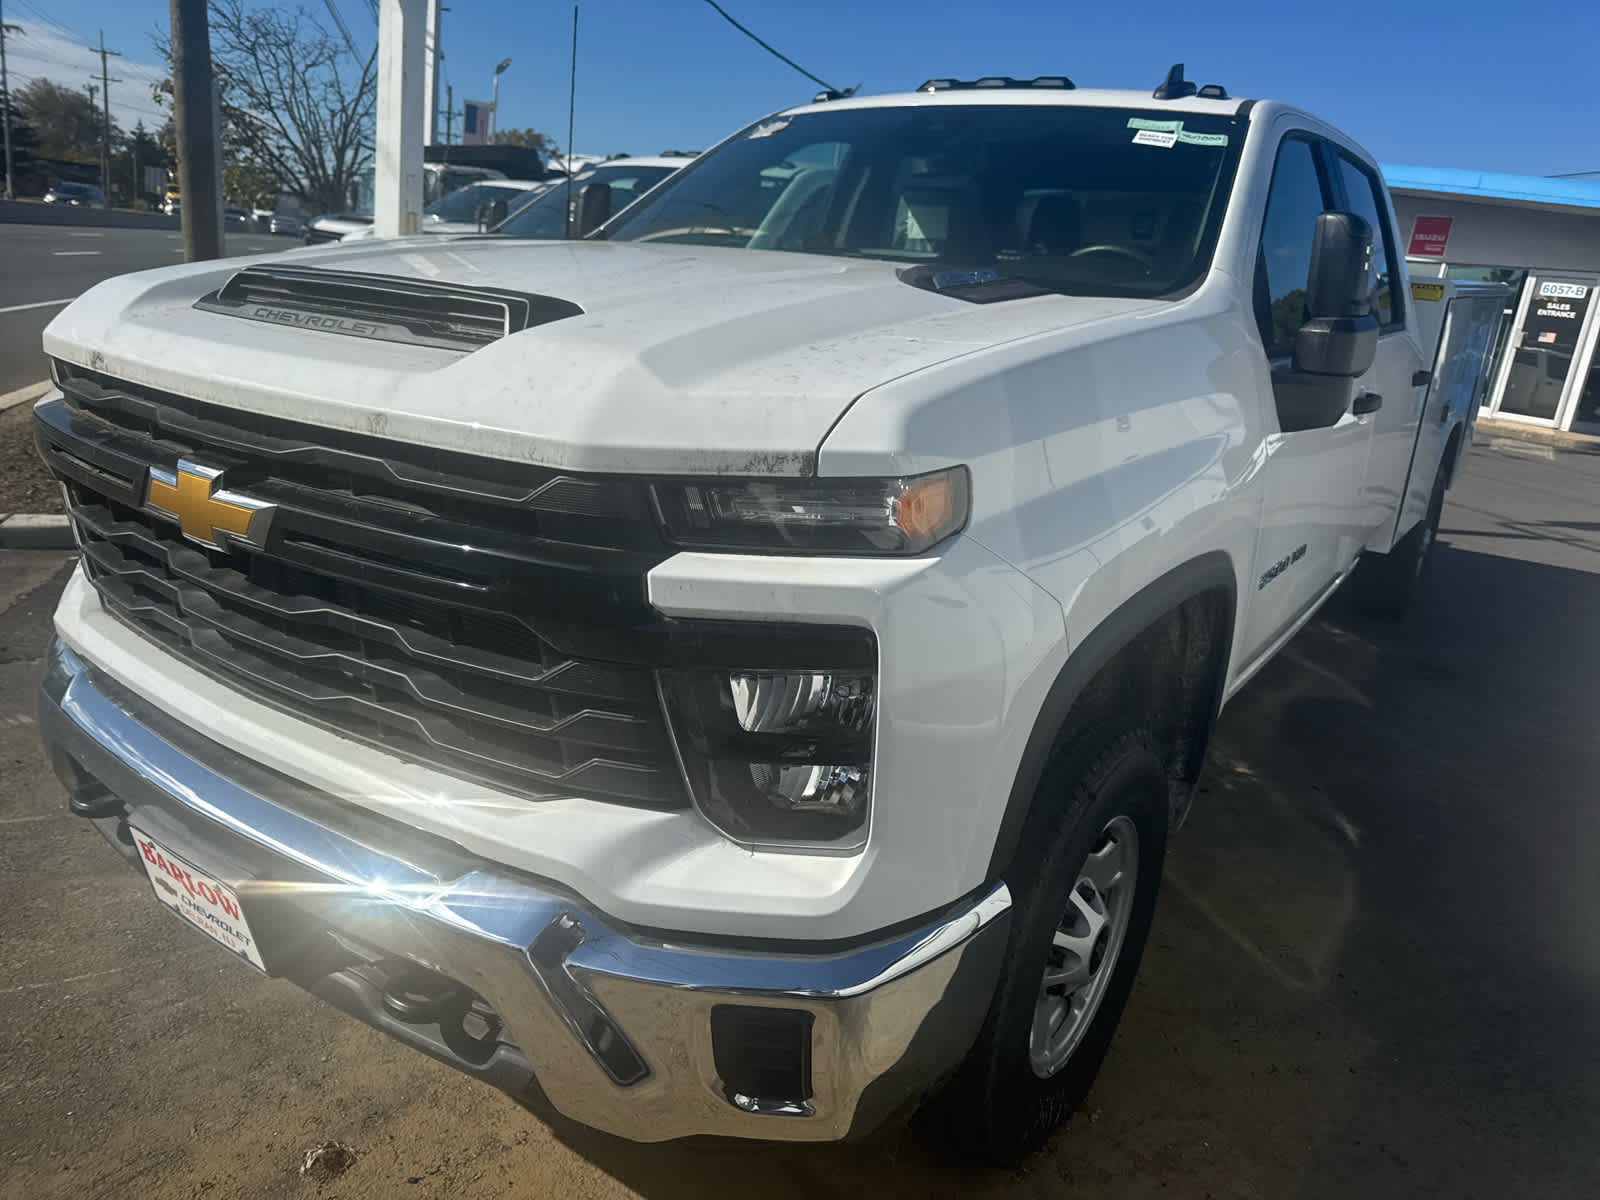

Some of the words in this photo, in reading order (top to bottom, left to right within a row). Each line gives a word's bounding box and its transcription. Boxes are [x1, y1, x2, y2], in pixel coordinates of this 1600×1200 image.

[1542, 284, 1585, 296] 6057-B
[1537, 309, 1576, 319] ENTRANCE
[1546, 302, 1571, 311] SALES
[254, 307, 388, 335] CHEVROLET
[137, 839, 240, 921] BARLOW
[180, 894, 251, 947] CHEVROLET
